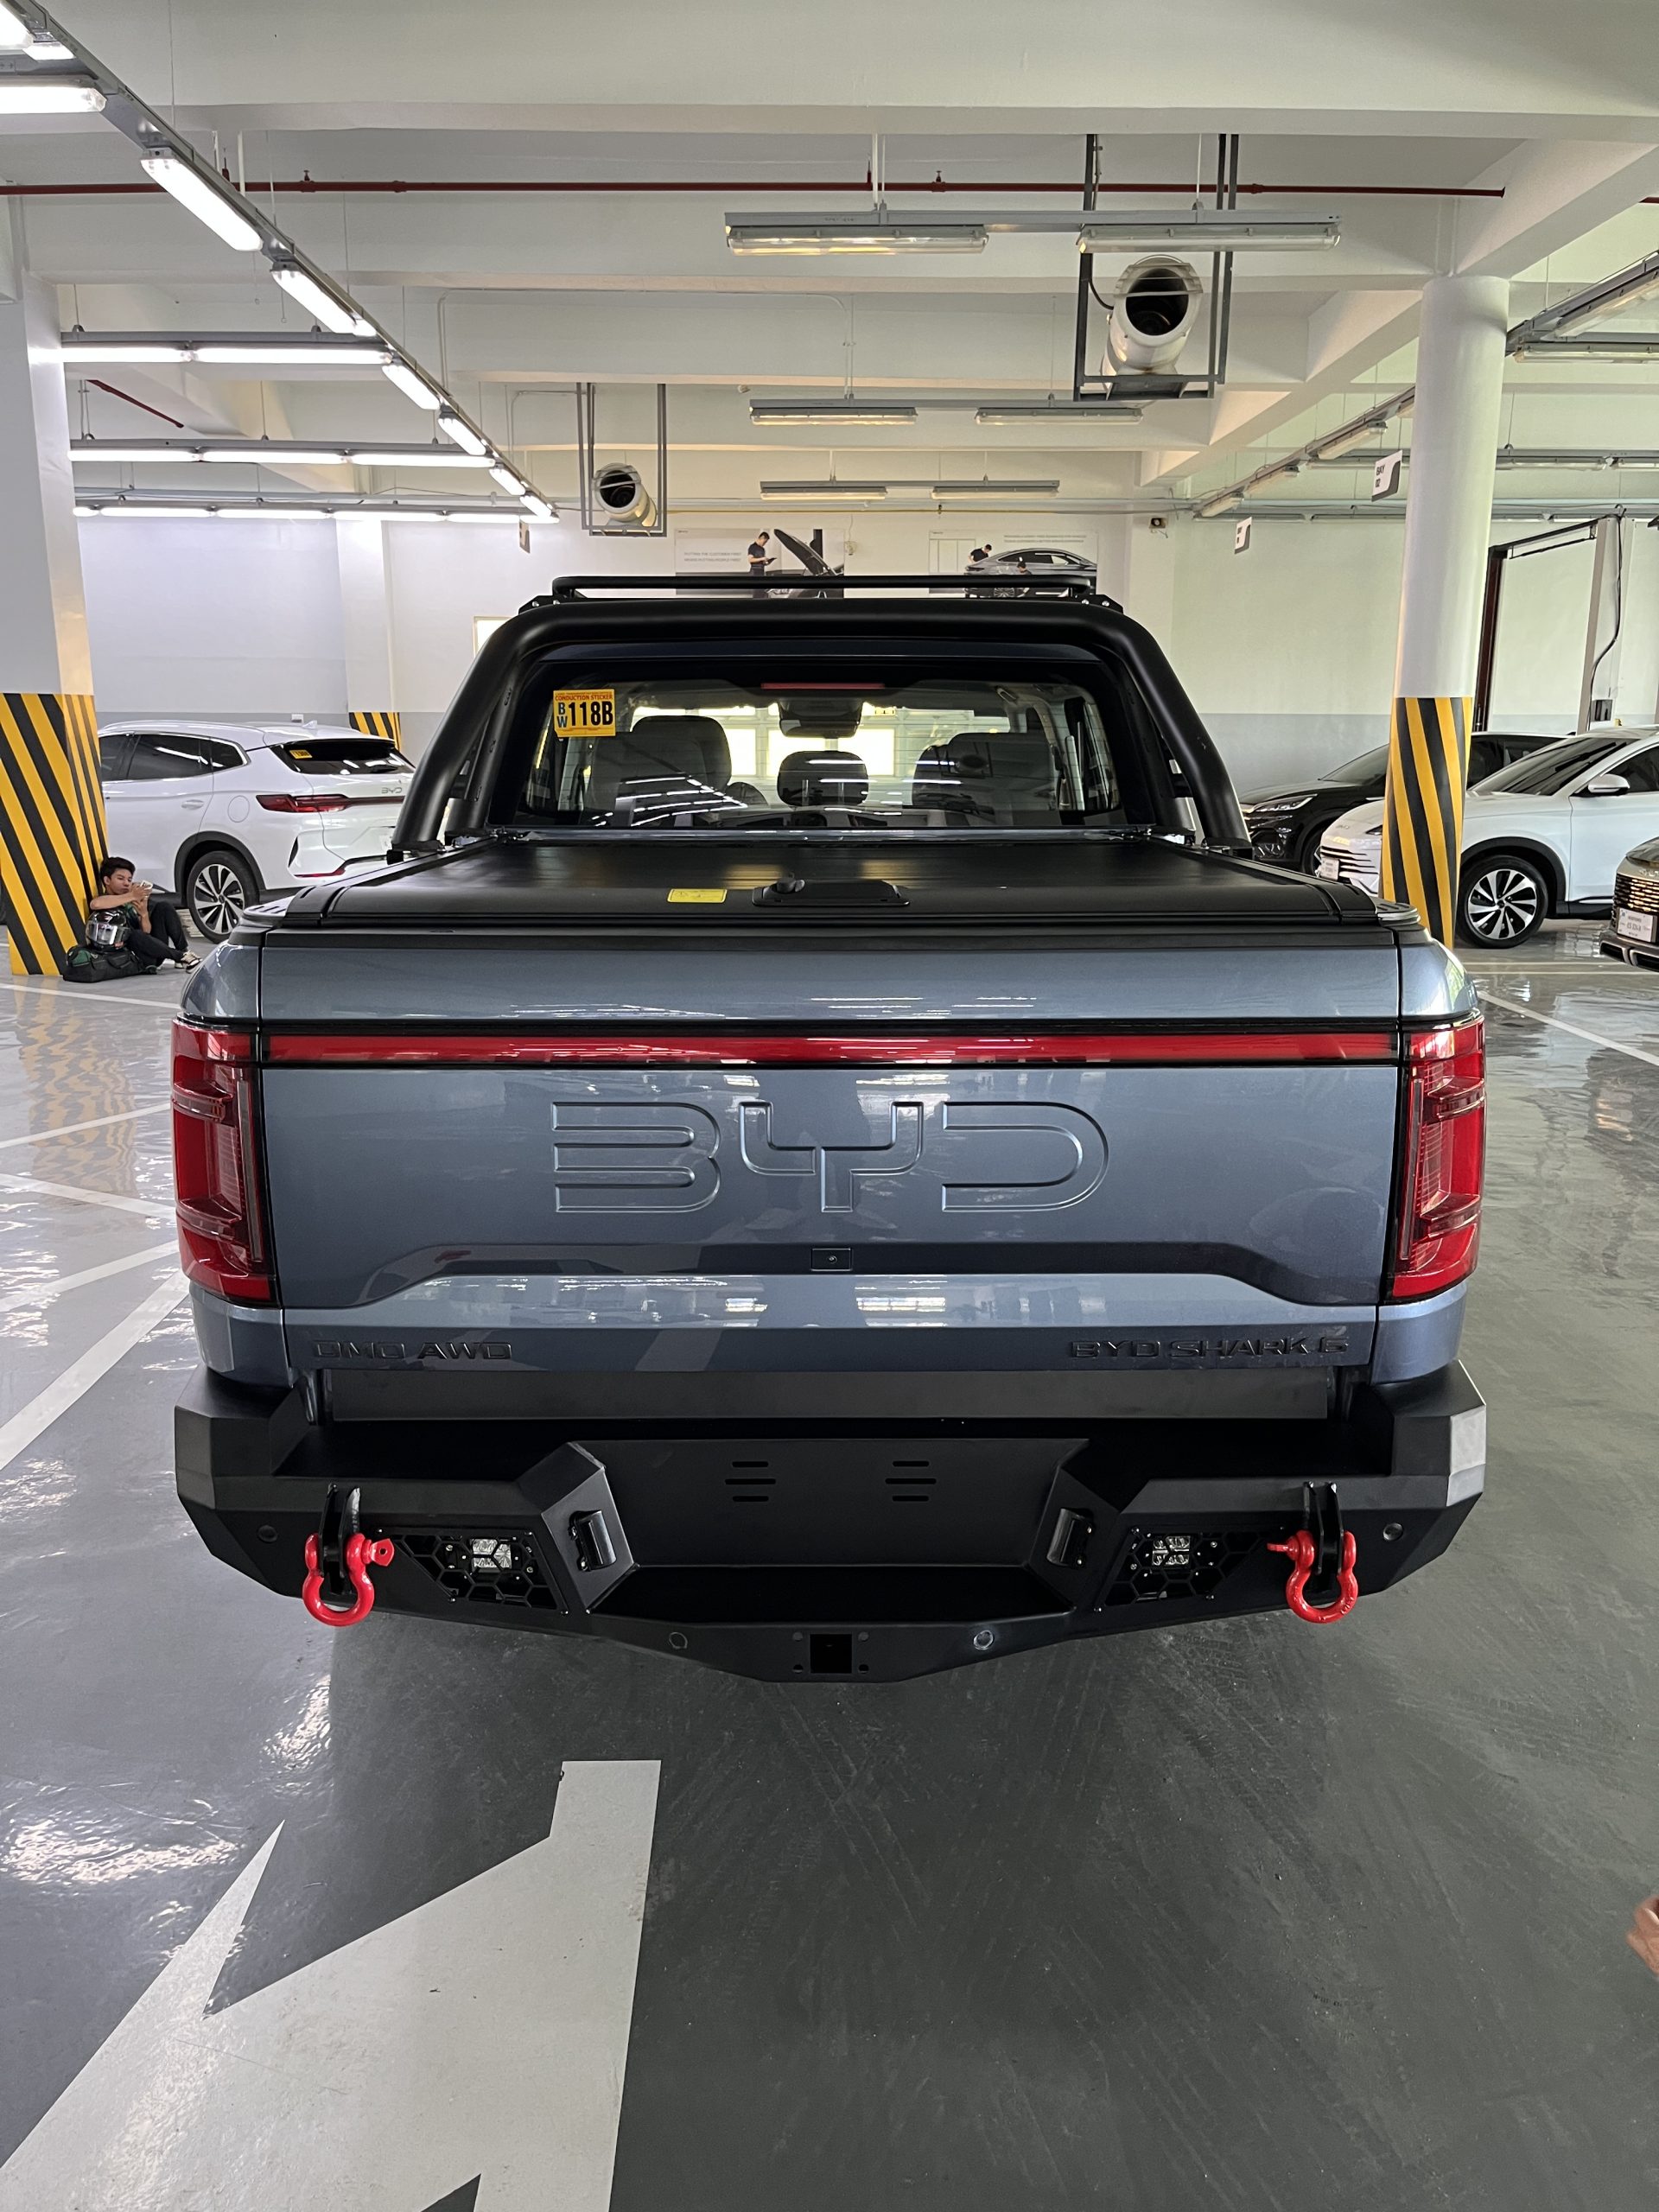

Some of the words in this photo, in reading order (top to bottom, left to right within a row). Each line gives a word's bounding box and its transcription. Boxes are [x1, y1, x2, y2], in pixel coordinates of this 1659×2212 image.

[569, 701, 613, 726] 118B
[551, 1101, 1109, 1213] BYD
[416, 1341, 512, 1360] AWD
[1070, 1340, 1161, 1358] BYD
[1170, 1336, 1310, 1357] SHARK
[1319, 1334, 1350, 1354] 6
